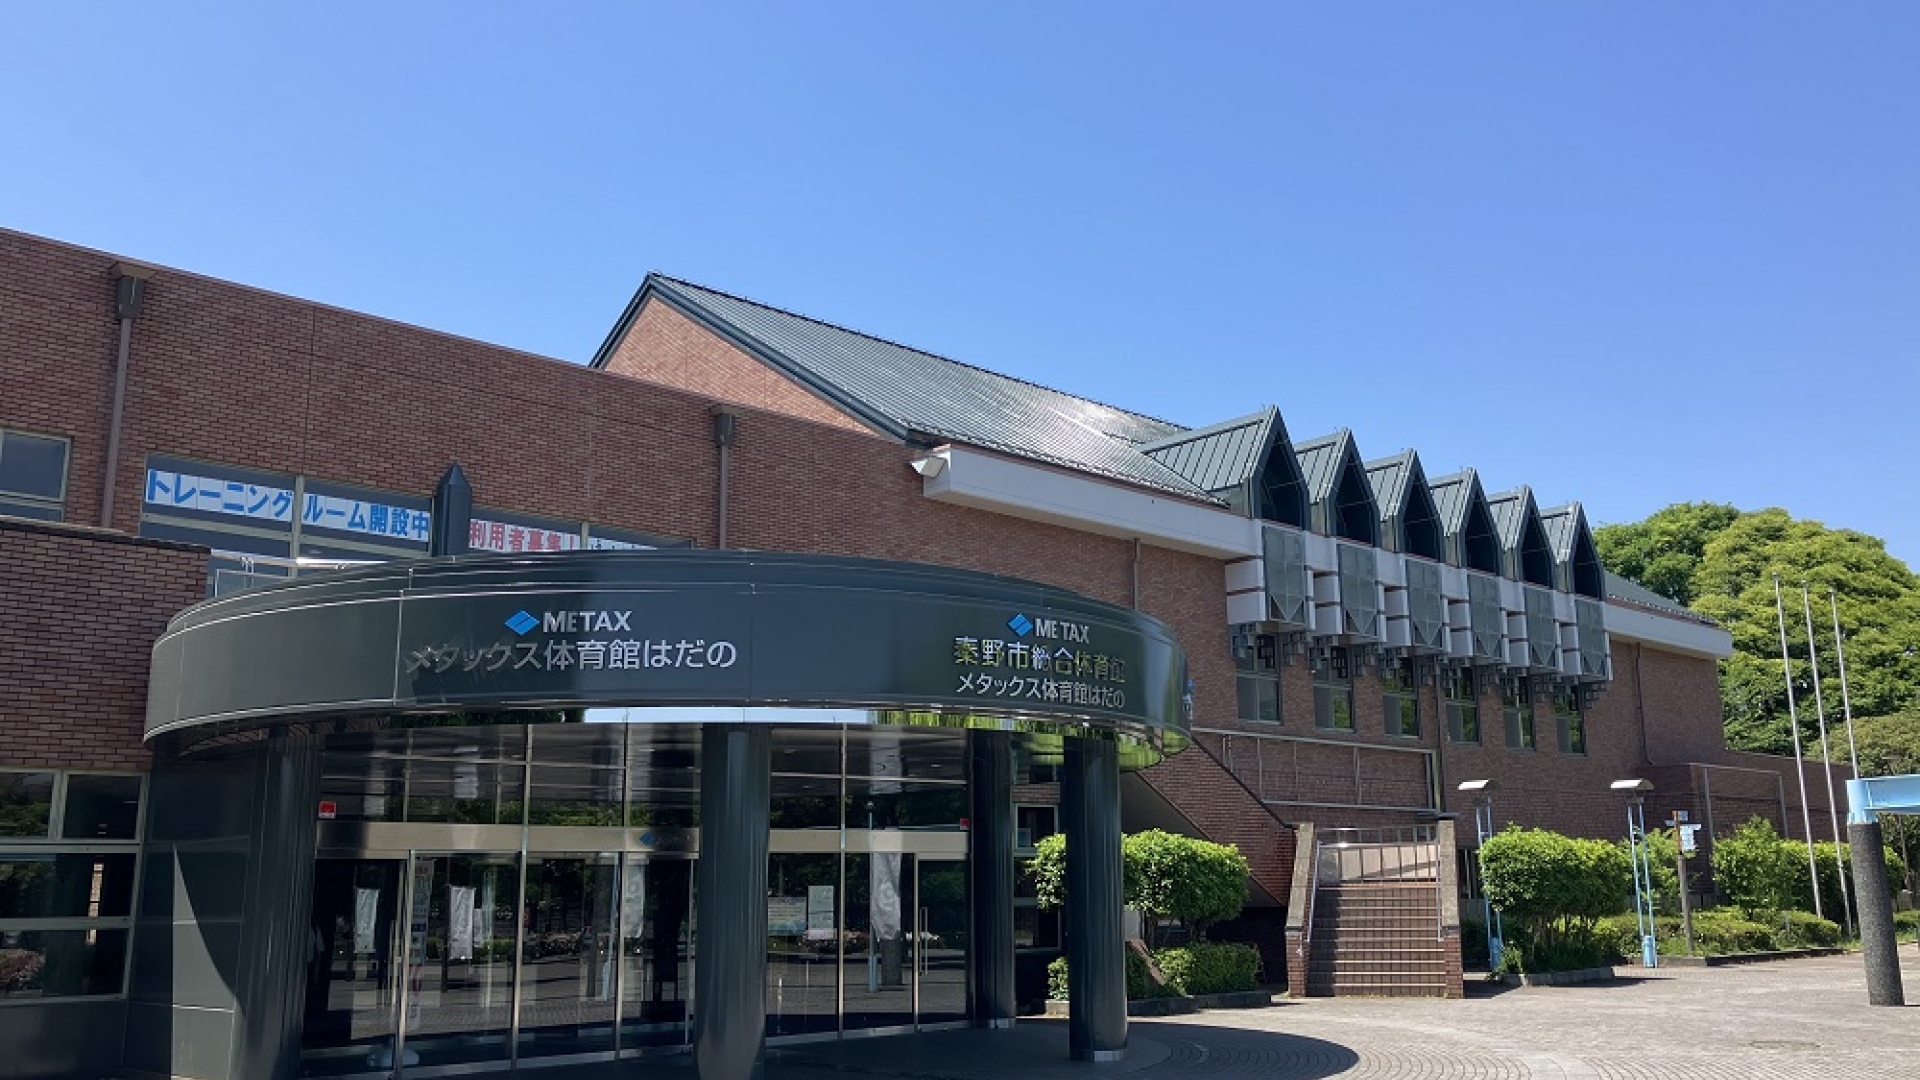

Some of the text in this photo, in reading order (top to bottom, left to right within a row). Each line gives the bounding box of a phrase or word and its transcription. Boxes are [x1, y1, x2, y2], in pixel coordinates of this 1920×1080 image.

[542, 610, 633, 633] METAX
[1035, 618, 1090, 644] METAX
[404, 638, 737, 673] メタックス体育館はだの
[954, 636, 1126, 683] 秦野市総合体育館
[956, 672, 1125, 709] メタックス体育館はだの
